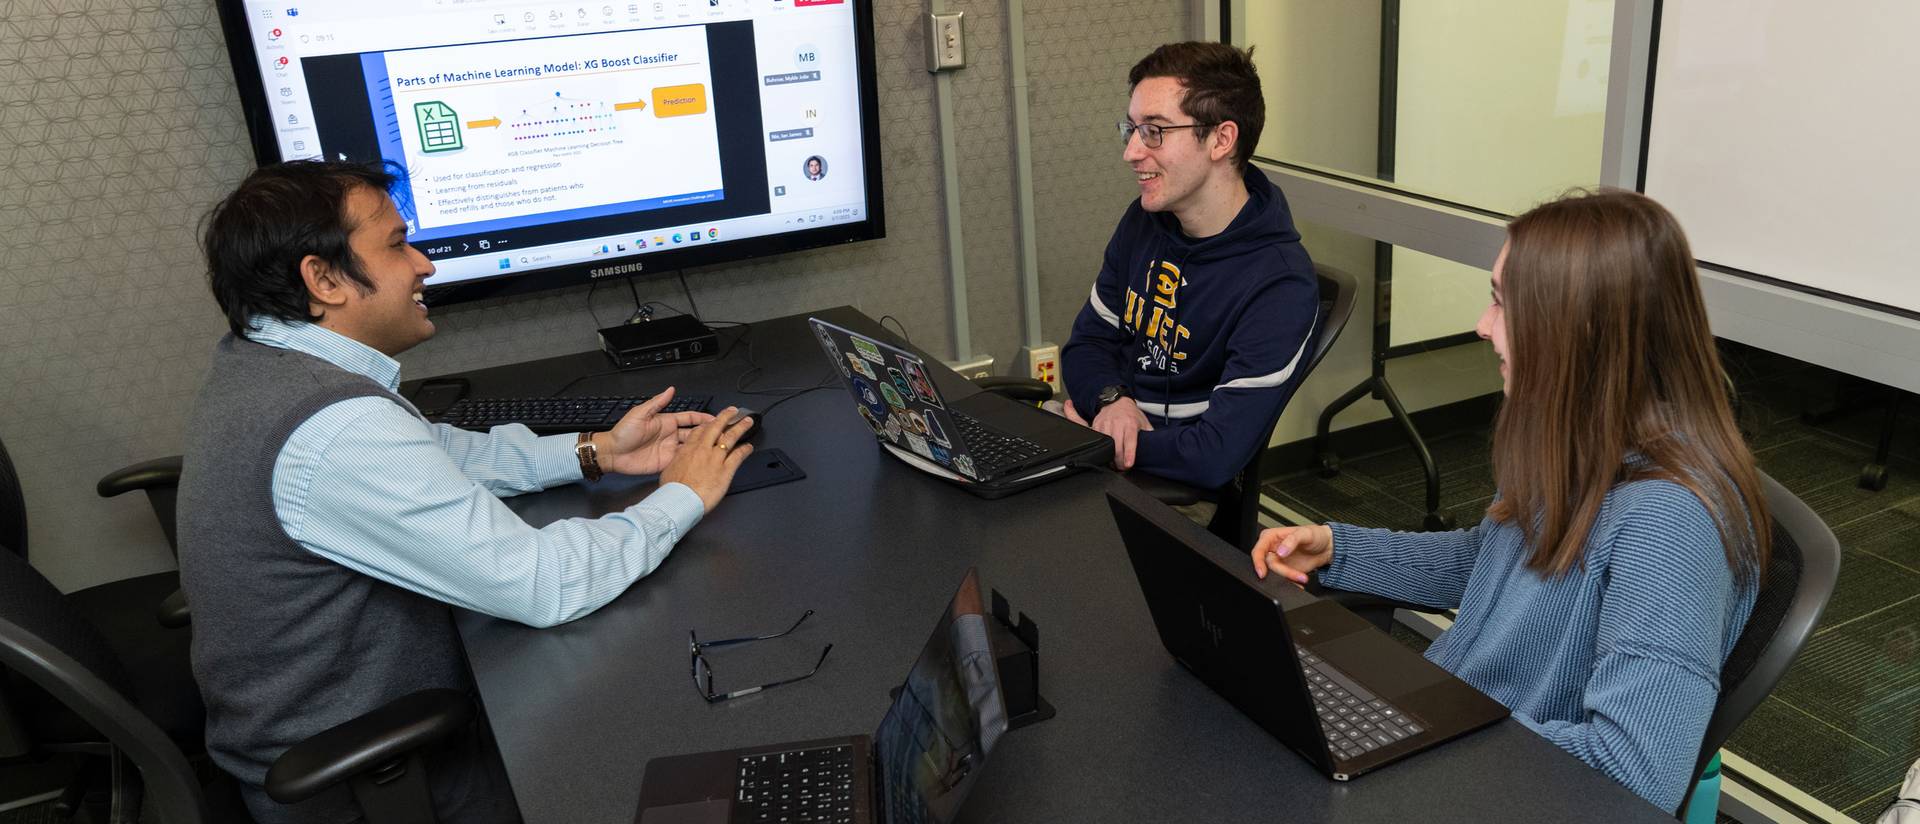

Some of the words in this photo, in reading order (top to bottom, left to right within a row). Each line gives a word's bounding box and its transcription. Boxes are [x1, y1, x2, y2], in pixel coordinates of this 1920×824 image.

[798, 52, 816, 63] MB
[396, 76, 426, 88] Parts
[428, 74, 441, 84] of
[443, 70, 492, 84] Machine
[494, 66, 541, 79] Learning
[543, 61, 581, 74] Model:
[583, 59, 599, 70] XG
[601, 57, 631, 69] Boost
[633, 53, 679, 66] Classifier
[663, 97, 697, 106] Prediction
[805, 109, 817, 119] IN
[433, 174, 452, 182] Used
[465, 168, 511, 178] classification
[511, 165, 525, 173] and
[526, 162, 562, 172] regression
[435, 184, 467, 195] Learning
[487, 178, 518, 188] residuals
[438, 197, 475, 207] Effectively
[475, 191, 521, 202] distinguishes
[522, 188, 539, 196] from
[540, 184, 568, 194] patients
[569, 182, 584, 190] who
[439, 207, 458, 216] need
[459, 204, 479, 213] refills
[480, 202, 494, 211] and
[495, 200, 515, 208] those
[516, 197, 532, 206] who
[427, 248, 436, 256] 10
[590, 262, 643, 279] SAMSUNG
